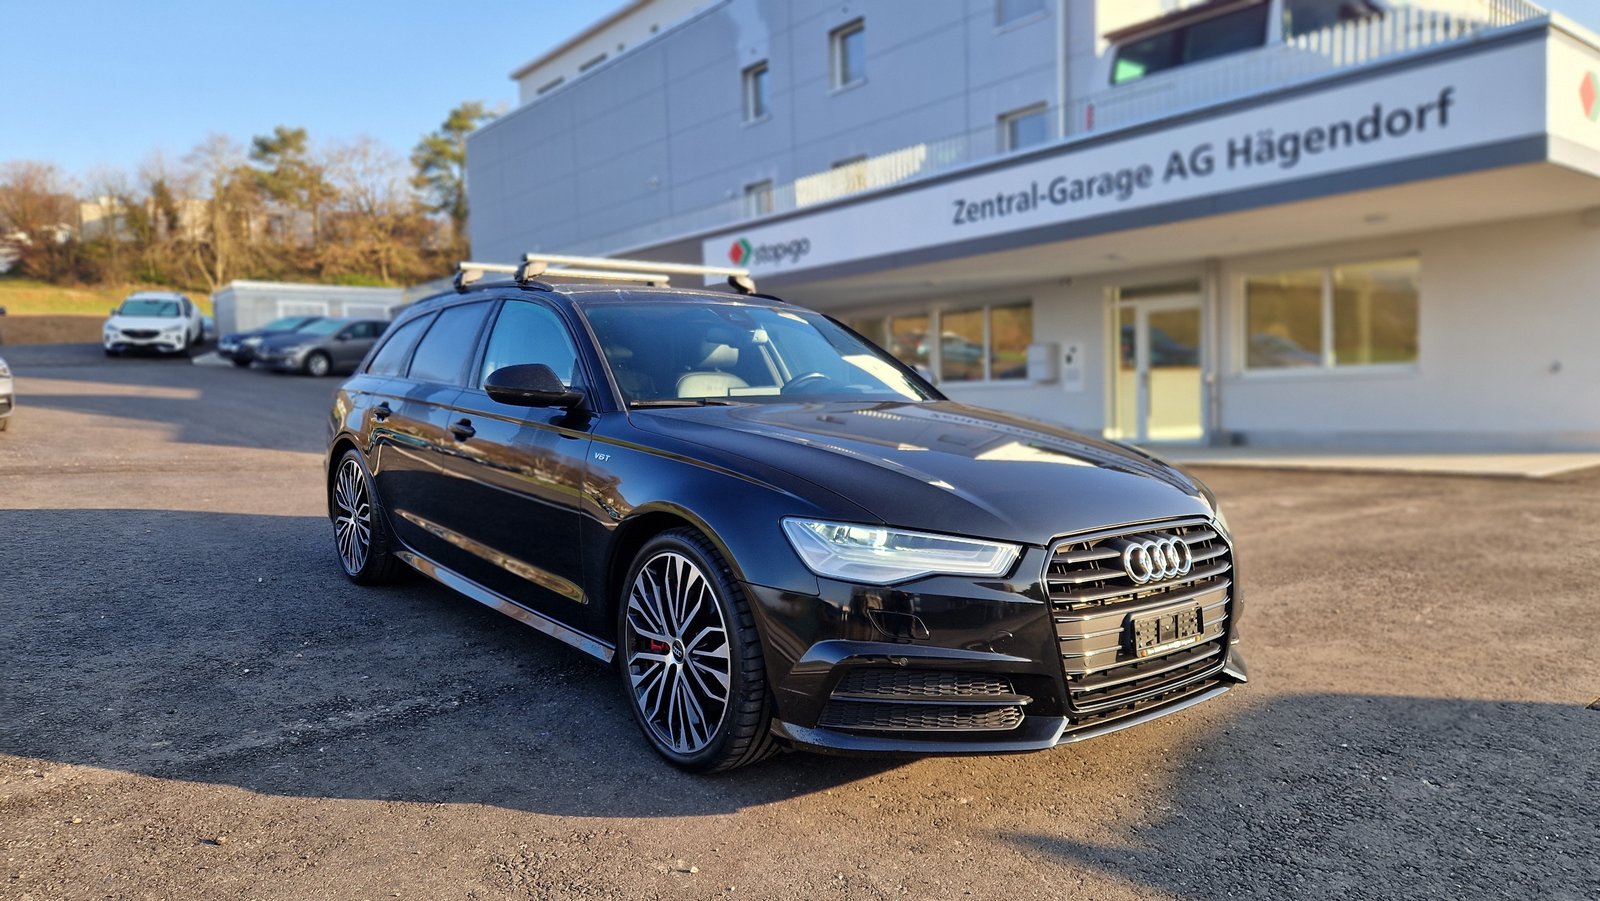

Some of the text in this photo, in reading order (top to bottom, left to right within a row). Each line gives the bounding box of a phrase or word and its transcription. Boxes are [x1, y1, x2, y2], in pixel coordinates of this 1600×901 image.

[952, 86, 1456, 226] Zentral-Garage AG Hägendorf
[594, 452, 611, 462] V6T
